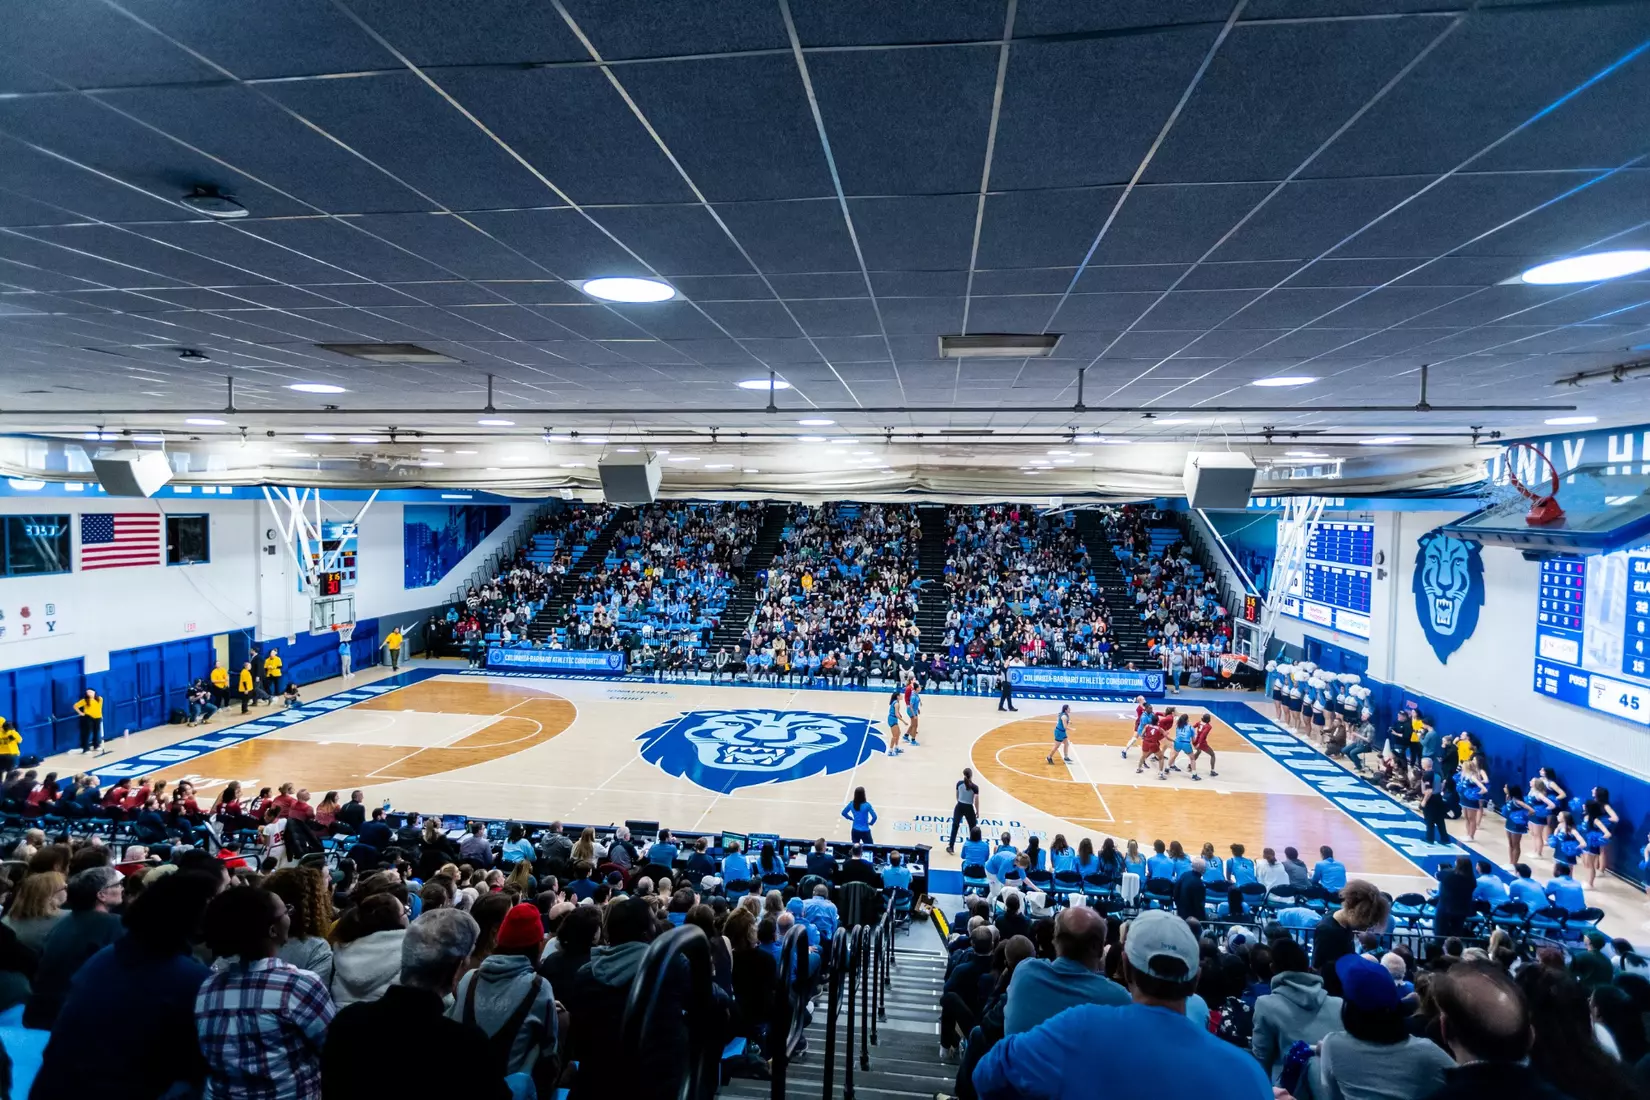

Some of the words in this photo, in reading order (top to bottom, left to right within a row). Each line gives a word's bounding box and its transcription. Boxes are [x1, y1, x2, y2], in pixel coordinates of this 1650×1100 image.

[46, 621, 56, 632] Y
[1079, 676, 1105, 685] ATHLETIC
[1619, 694, 1639, 710] 45
[92, 684, 401, 777] COLUMBIA
[912, 815, 1003, 827] JONAAN
